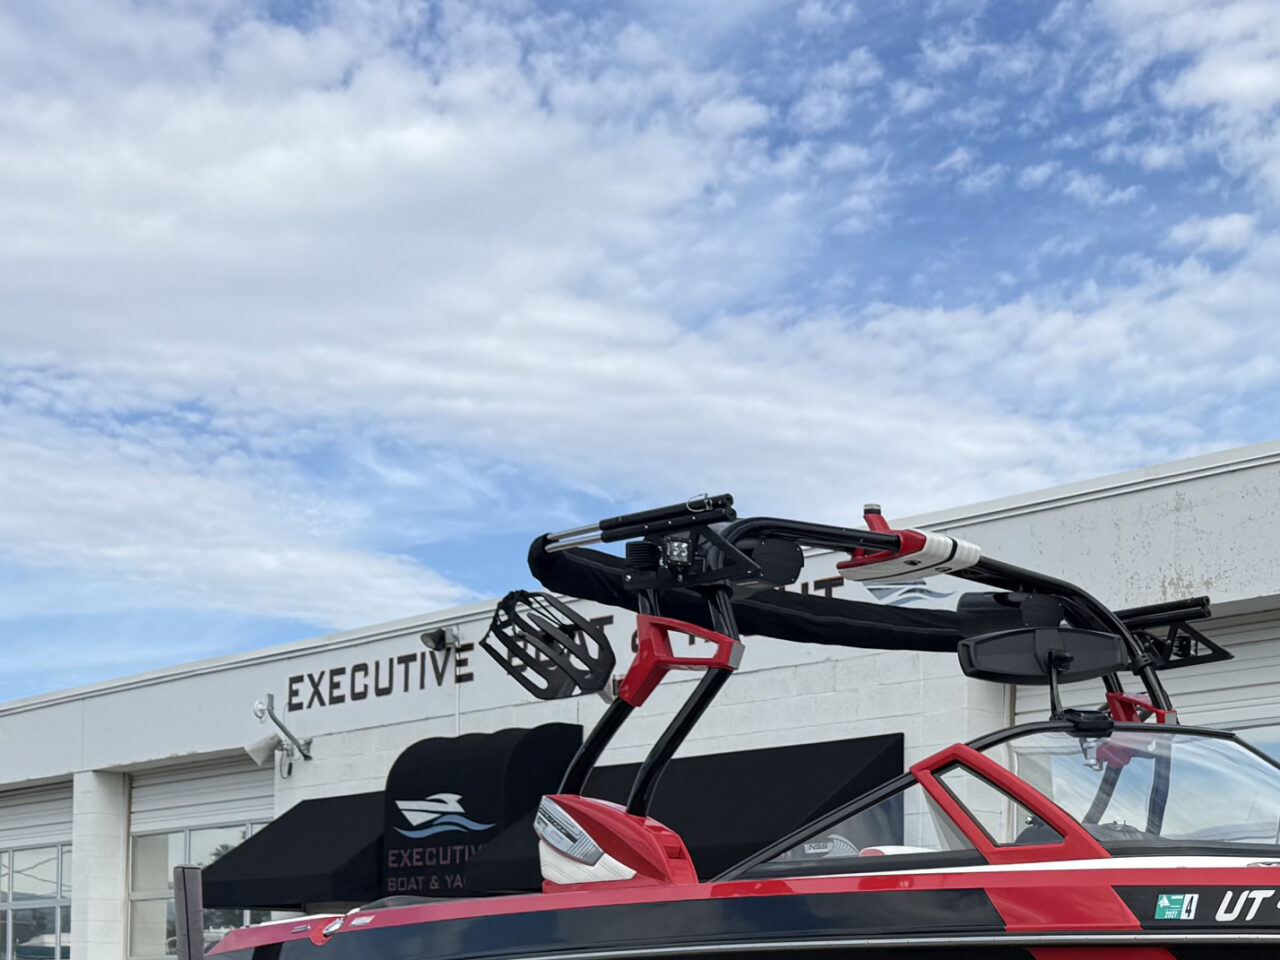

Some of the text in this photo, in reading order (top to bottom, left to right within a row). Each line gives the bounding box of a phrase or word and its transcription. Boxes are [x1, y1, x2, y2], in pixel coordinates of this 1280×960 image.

[287, 642, 474, 712] EXECUTIVE
[388, 874, 466, 892] BOAT & YA
[1215, 890, 1276, 921] UT
